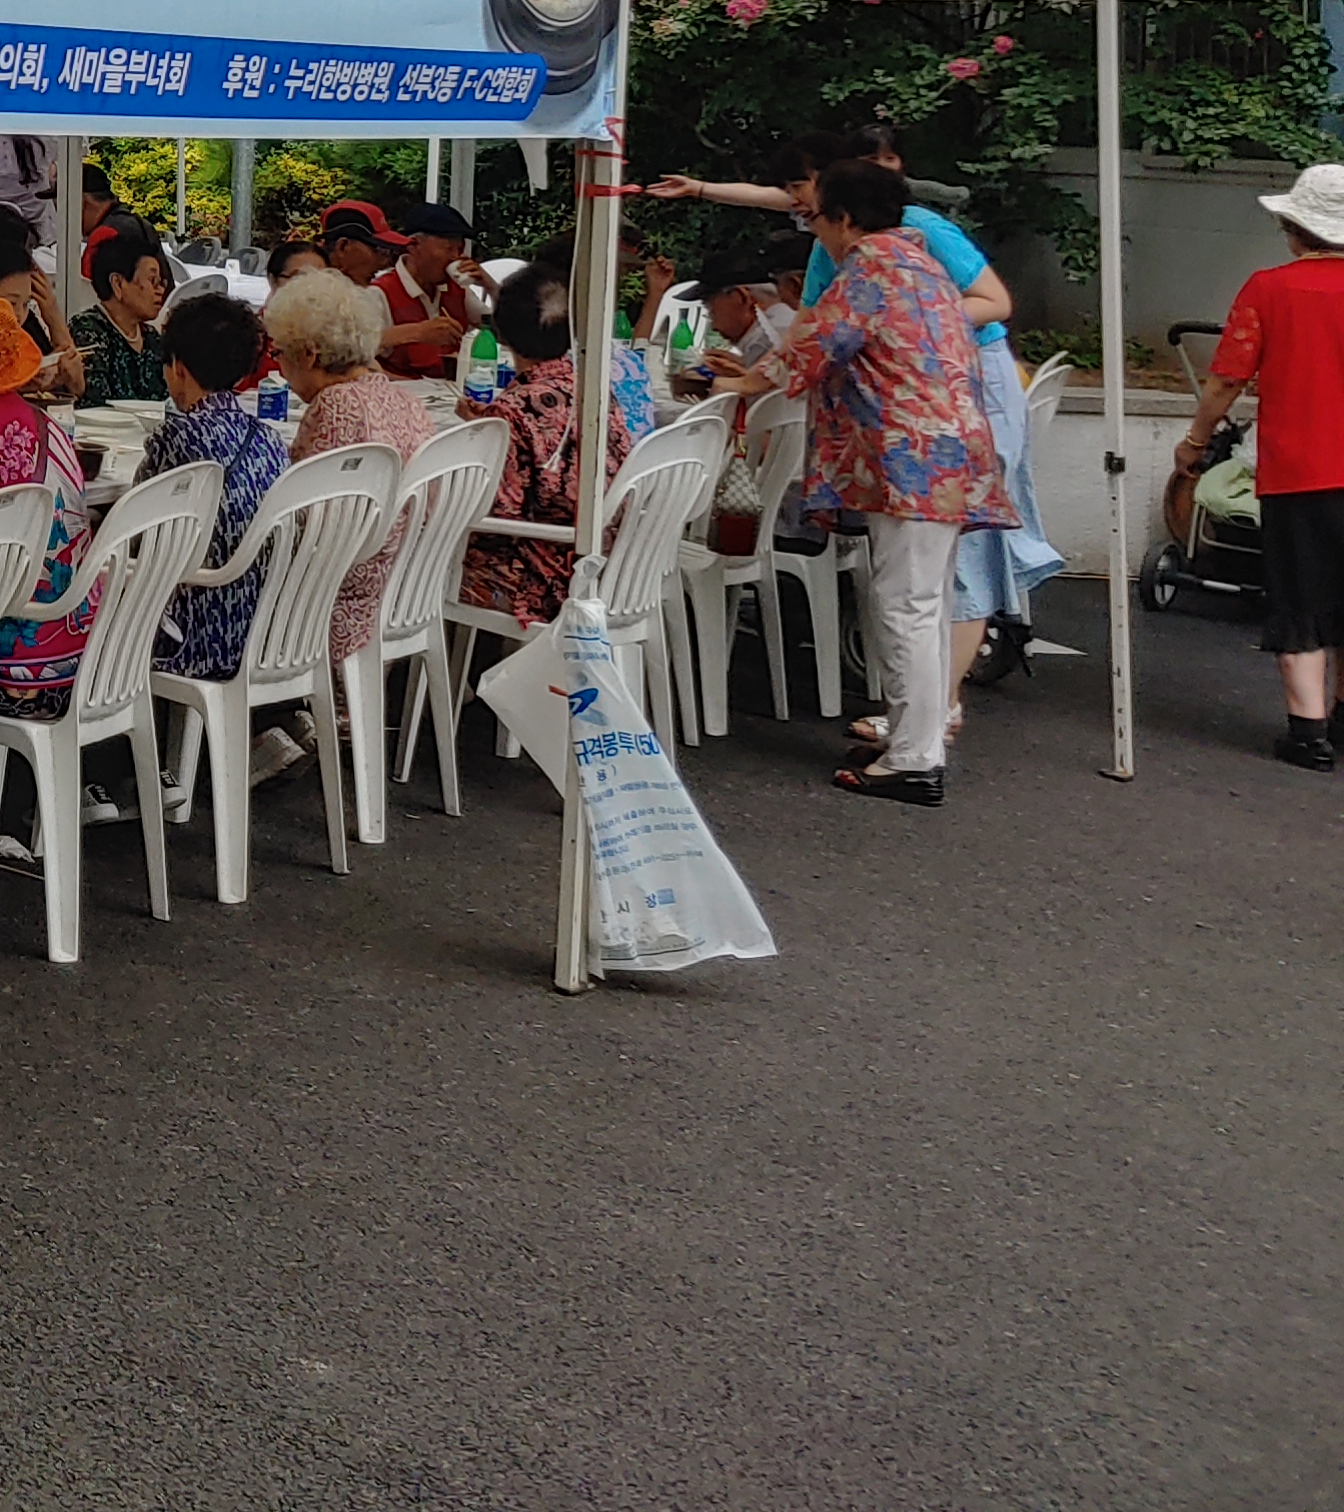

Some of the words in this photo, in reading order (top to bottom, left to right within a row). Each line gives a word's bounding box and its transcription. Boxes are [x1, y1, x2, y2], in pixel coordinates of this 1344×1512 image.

[57, 45, 193, 97] 새마을부녀회
[221, 53, 269, 99] 후원
[283, 58, 396, 104] 누리한방병원,
[395, 63, 463, 104] 선부3동
